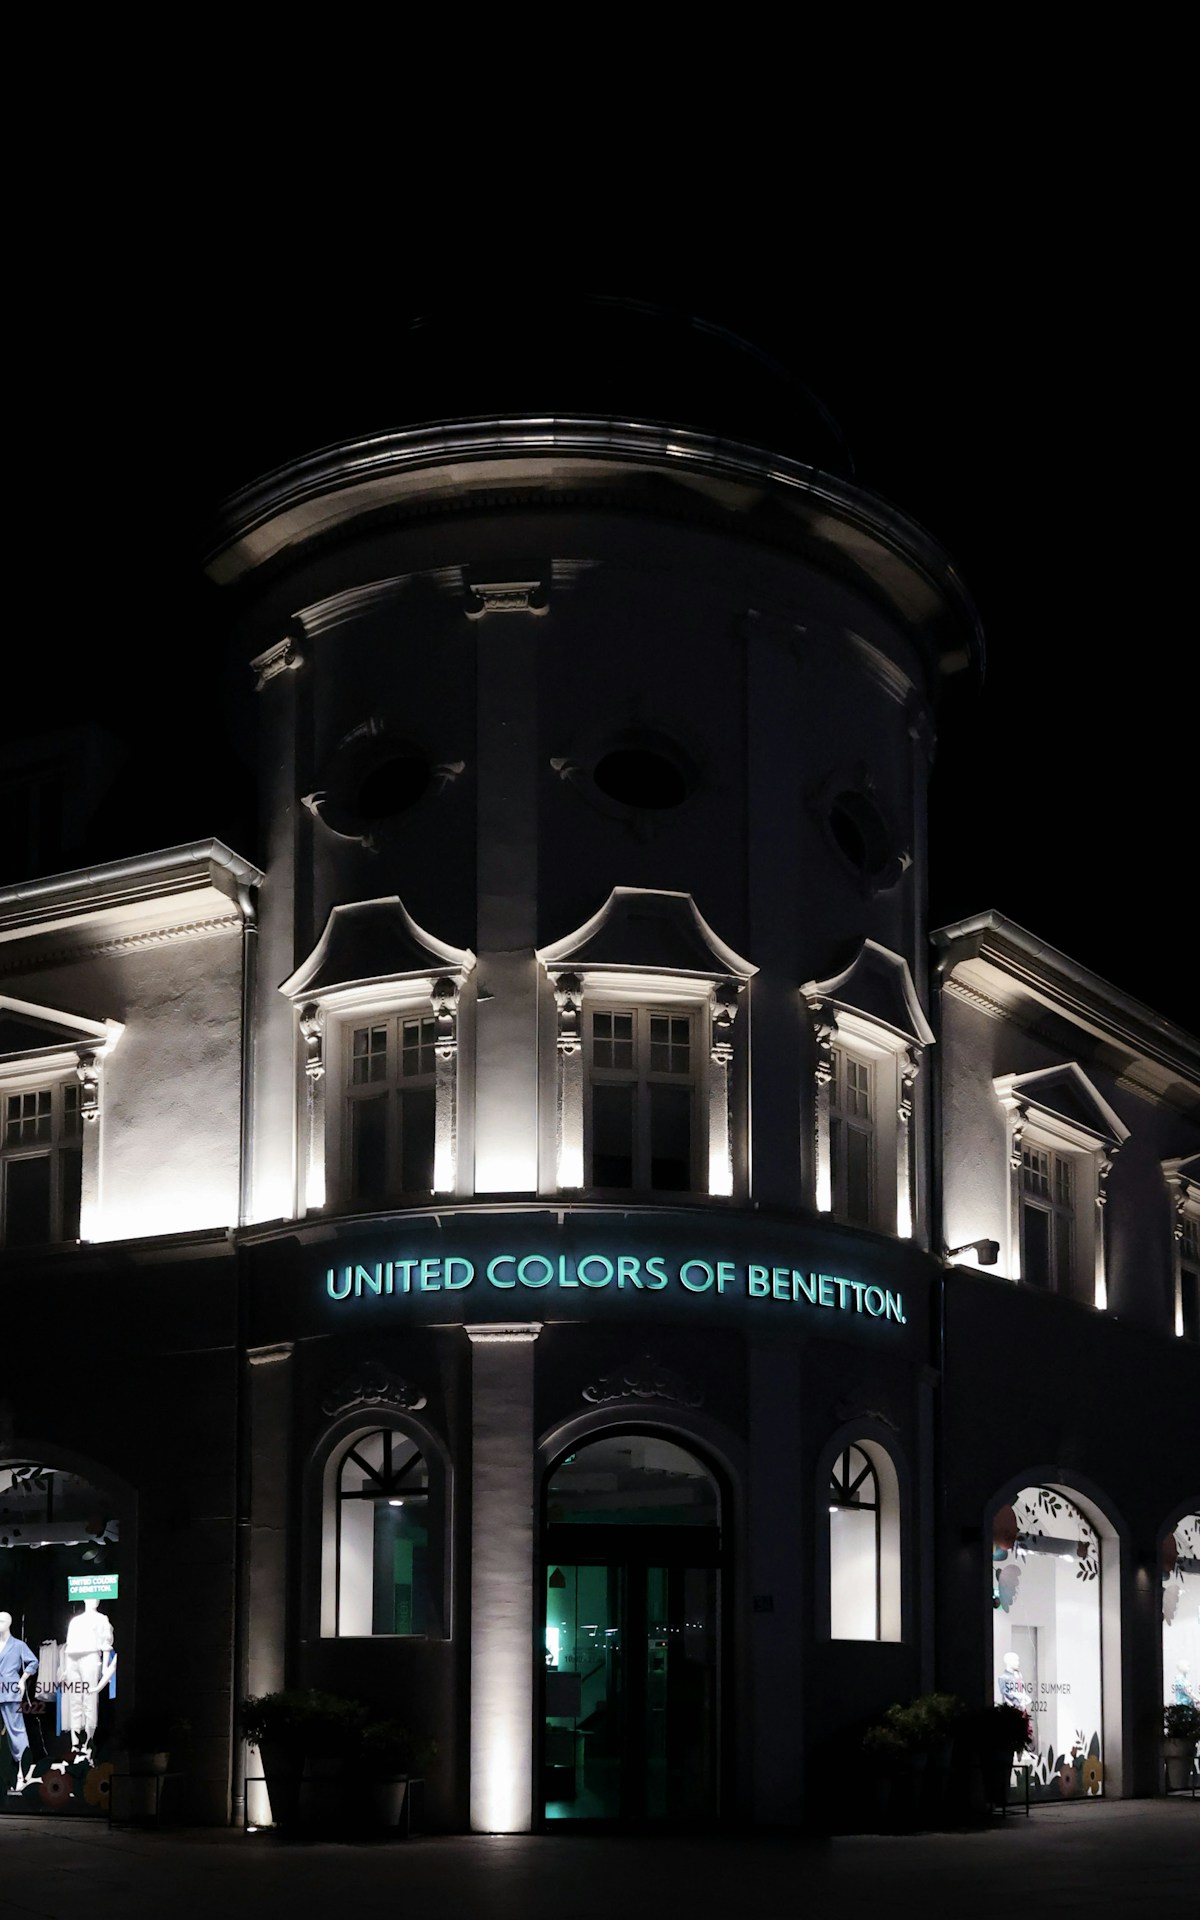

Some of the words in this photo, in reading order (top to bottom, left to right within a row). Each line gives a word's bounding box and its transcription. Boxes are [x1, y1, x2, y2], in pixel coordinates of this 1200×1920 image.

[326, 1257, 475, 1300] UNITED
[486, 1254, 669, 1291] COLORS
[680, 1258, 736, 1294] OF
[748, 1264, 907, 1324] BENETTON.
[69, 1578, 92, 1586] UNITED
[92, 1577, 117, 1585] COLORS
[35, 1681, 90, 1694] SUMMER
[1004, 1682, 1033, 1694] SPRING
[1040, 1683, 1071, 1695] SUMMER
[16, 1701, 46, 1714] 2022
[1030, 1700, 1048, 1712] 2022
